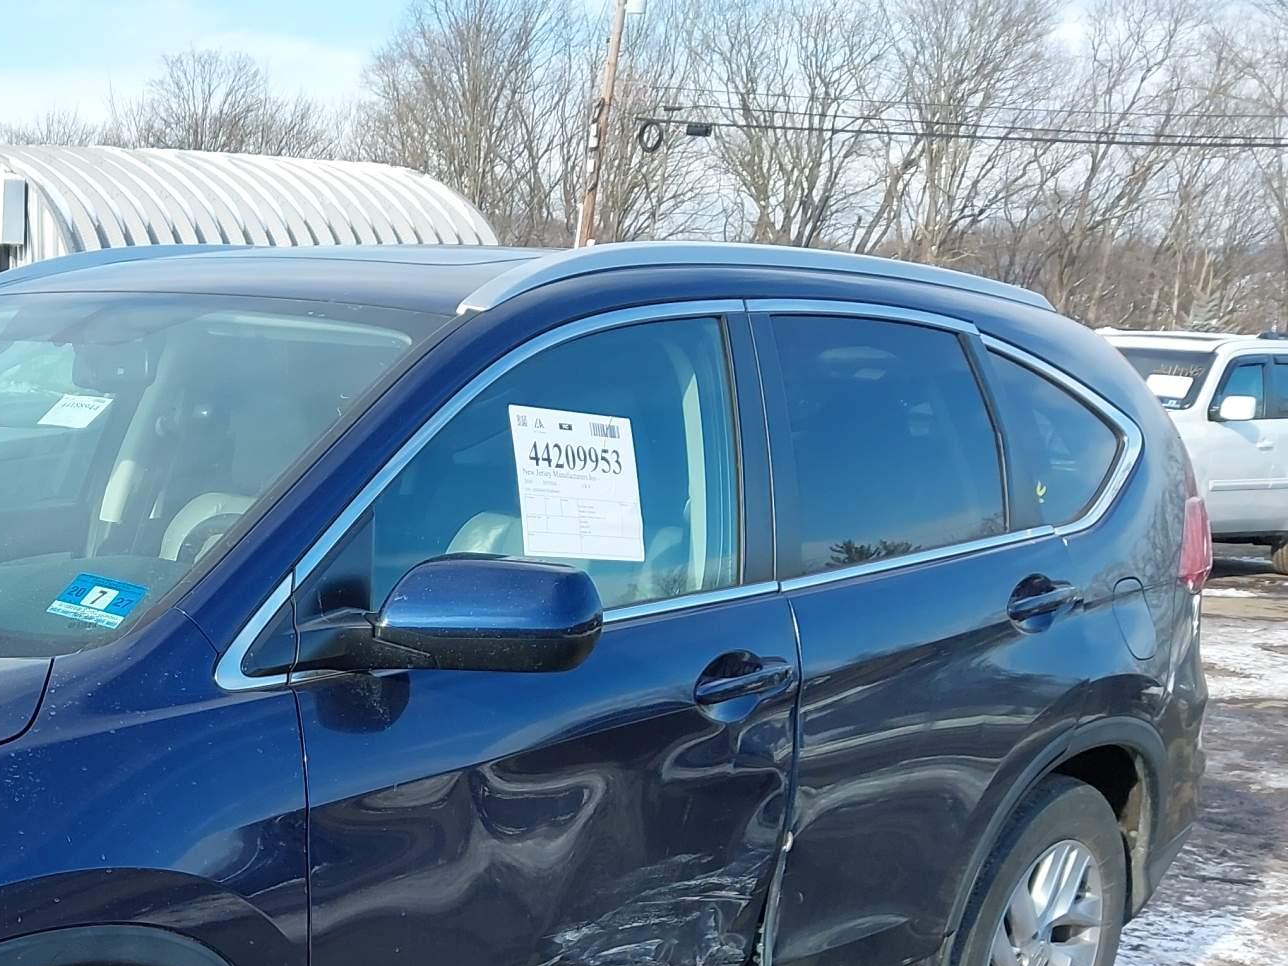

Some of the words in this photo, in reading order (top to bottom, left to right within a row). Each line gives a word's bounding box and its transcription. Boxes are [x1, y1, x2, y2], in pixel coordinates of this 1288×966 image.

[529, 440, 622, 475] 44209953
[68, 586, 88, 598] 20
[90, 590, 108, 605] 7
[112, 597, 134, 609] 27
